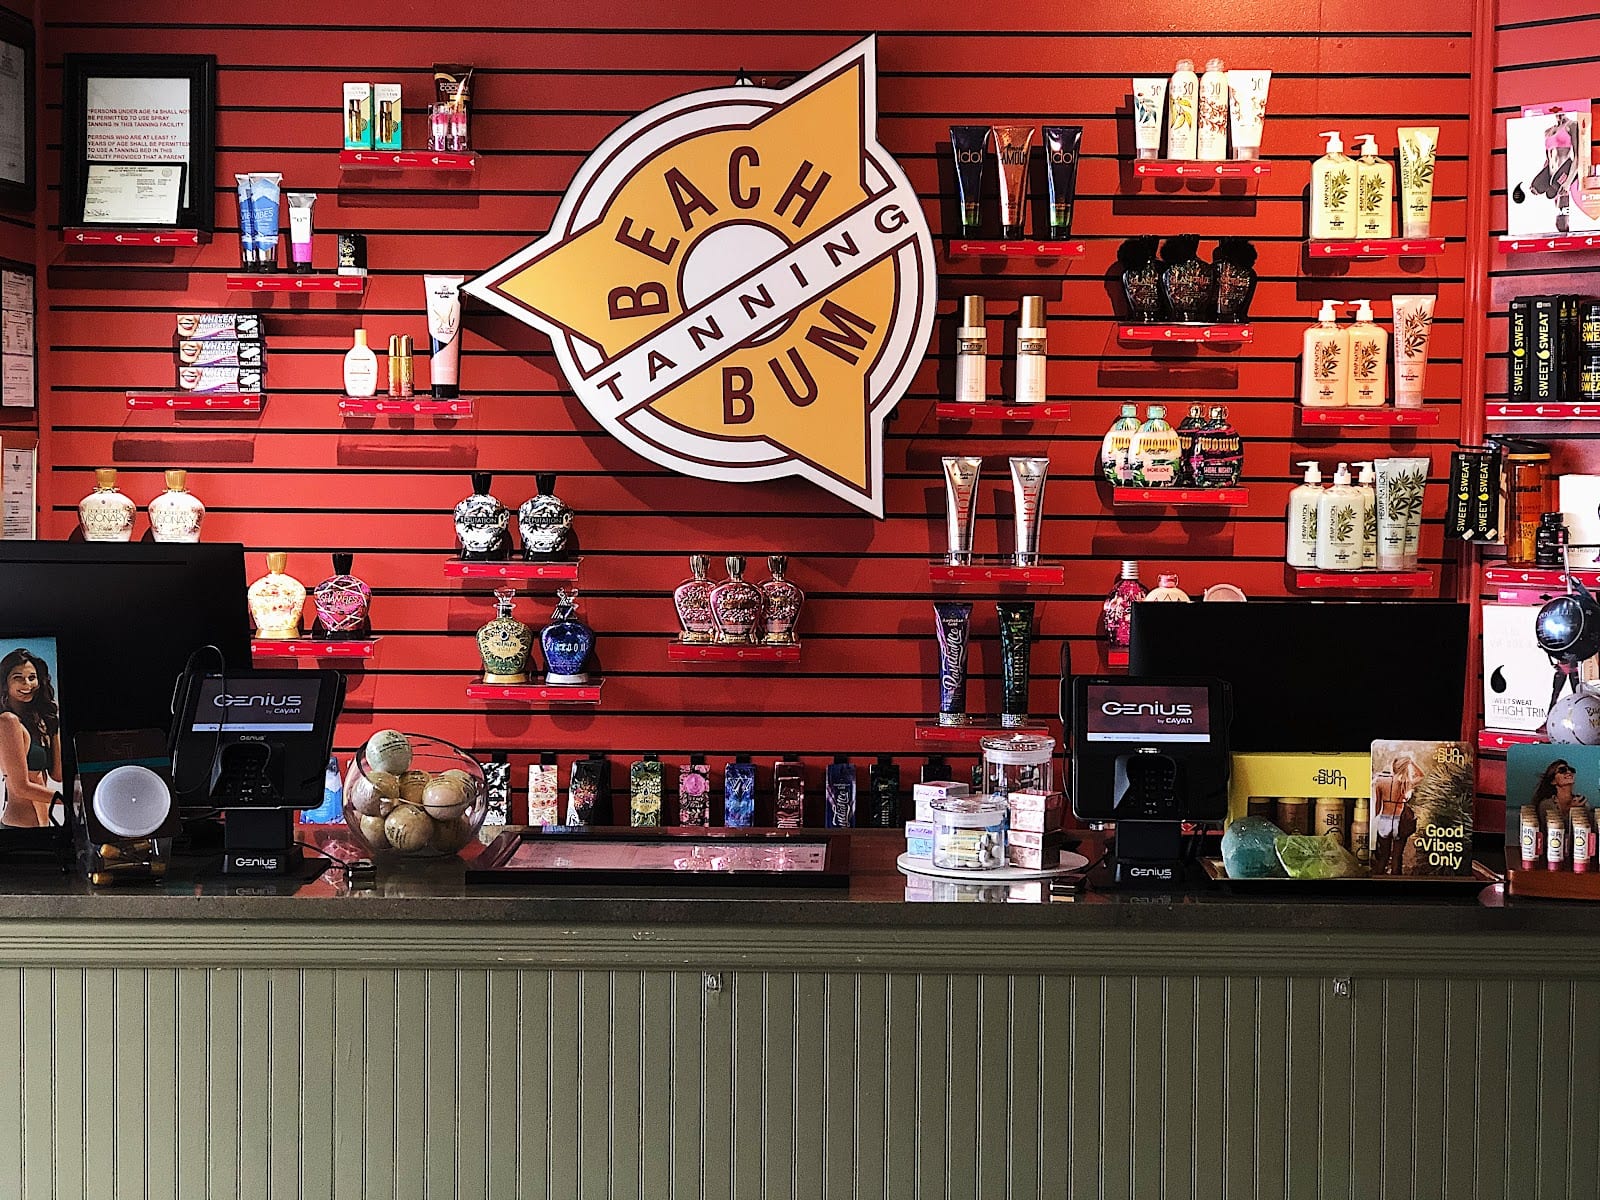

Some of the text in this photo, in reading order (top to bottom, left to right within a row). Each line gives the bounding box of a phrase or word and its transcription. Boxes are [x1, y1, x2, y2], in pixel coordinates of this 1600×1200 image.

[1182, 82, 1194, 95] 30
[608, 146, 832, 320] BEACH
[597, 204, 907, 402] TANNING
[1583, 322, 1600, 331] SWE
[1582, 332, 1600, 341] SWE
[202, 341, 240, 350] WHITEN
[1514, 313, 1523, 391] SWEET SWEAT
[722, 300, 876, 424] BUM
[1539, 312, 1548, 397] SWEET SWEAT
[1582, 372, 1600, 381] SWEE
[1582, 382, 1600, 391] SWEA
[1456, 461, 1469, 531] SWEET SWEAT
[1479, 462, 1488, 531] SWEET SWEAT
[1013, 634, 1024, 693] CURRENT
[1491, 705, 1524, 716] THIGH
[1426, 824, 1463, 838] Good
[1415, 838, 1463, 852] Vibes
[1429, 853, 1462, 870] Only
